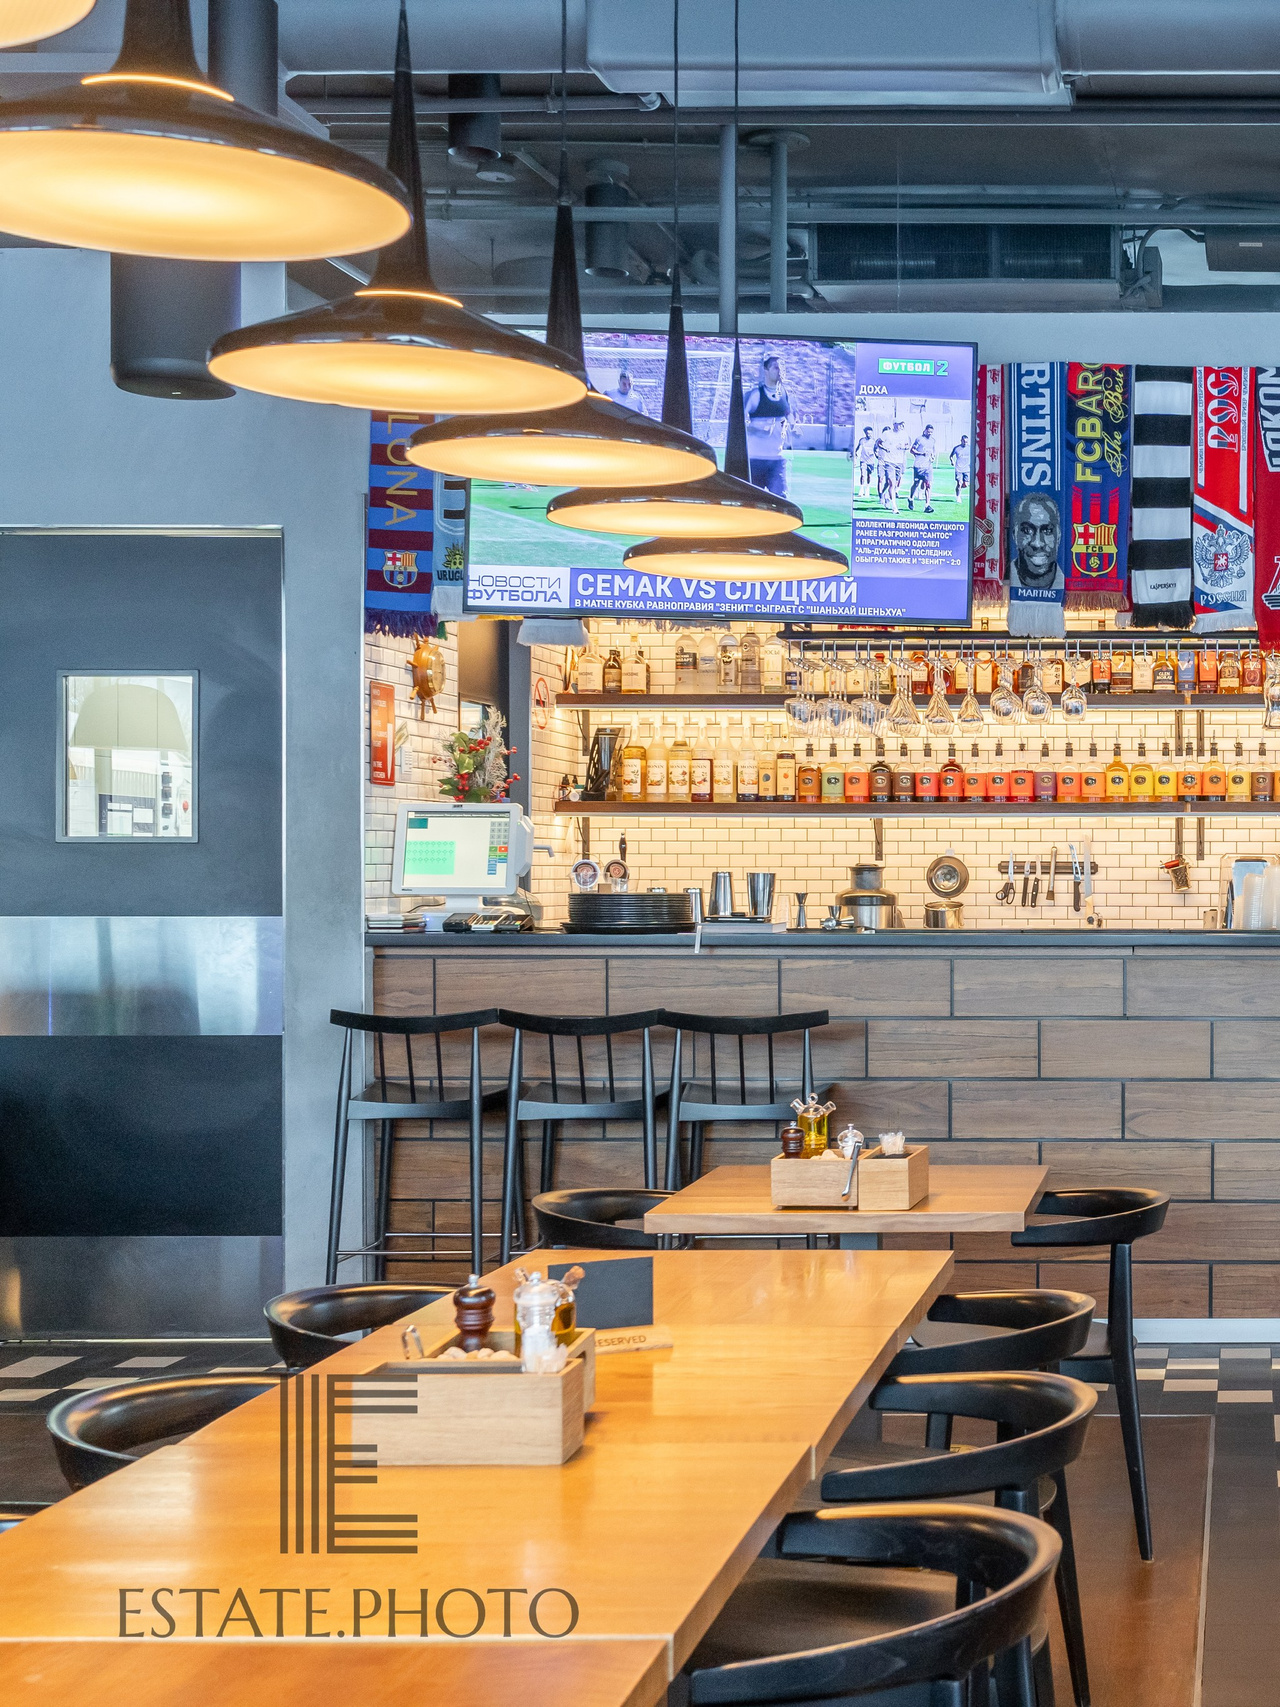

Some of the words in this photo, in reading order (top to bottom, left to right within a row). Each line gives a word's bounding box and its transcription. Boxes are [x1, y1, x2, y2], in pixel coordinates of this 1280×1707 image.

[883, 361, 931, 372] ФУТБОЛ
[936, 360, 949, 376] 2
[859, 385, 888, 395] ДОХА
[1102, 368, 1128, 424] Best
[1207, 366, 1240, 453] РОС
[1101, 431, 1128, 477] The
[855, 521, 895, 529] КОЛЛЕКТИВ
[896, 522, 929, 530] ЛЕОНИДА
[929, 523, 965, 531] СЛУЦКОГО
[861, 539, 911, 547] ПРАГМАТИЧНО
[912, 540, 940, 548] ОДОЛЕЛ
[855, 556, 887, 564] ОБЫГРАЛ
[911, 549, 952, 557] ПОСЛЕДНИХ
[469, 575, 562, 590] НОВОСТИ
[577, 573, 673, 598] СЕМАК
[681, 578, 717, 599] VS
[724, 576, 858, 605] СЛУЦКИЙ
[467, 589, 562, 603] ФУТБОЛА
[1018, 587, 1057, 599] MARTINS
[1200, 590, 1247, 606] РОССИЯ
[575, 599, 582, 607] В
[583, 600, 613, 608] МАТЧЕ
[614, 600, 645, 609] КУБКА
[646, 601, 714, 611] РАВНОПРАВИЯ
[716, 603, 753, 612] "ЗЕНИТ"
[755, 604, 798, 614] СЫГРАЕТ
[798, 605, 805, 613] С
[806, 605, 856, 615] "ШАНЬХАЙ
[858, 607, 906, 617] ШЕНЬХУА"
